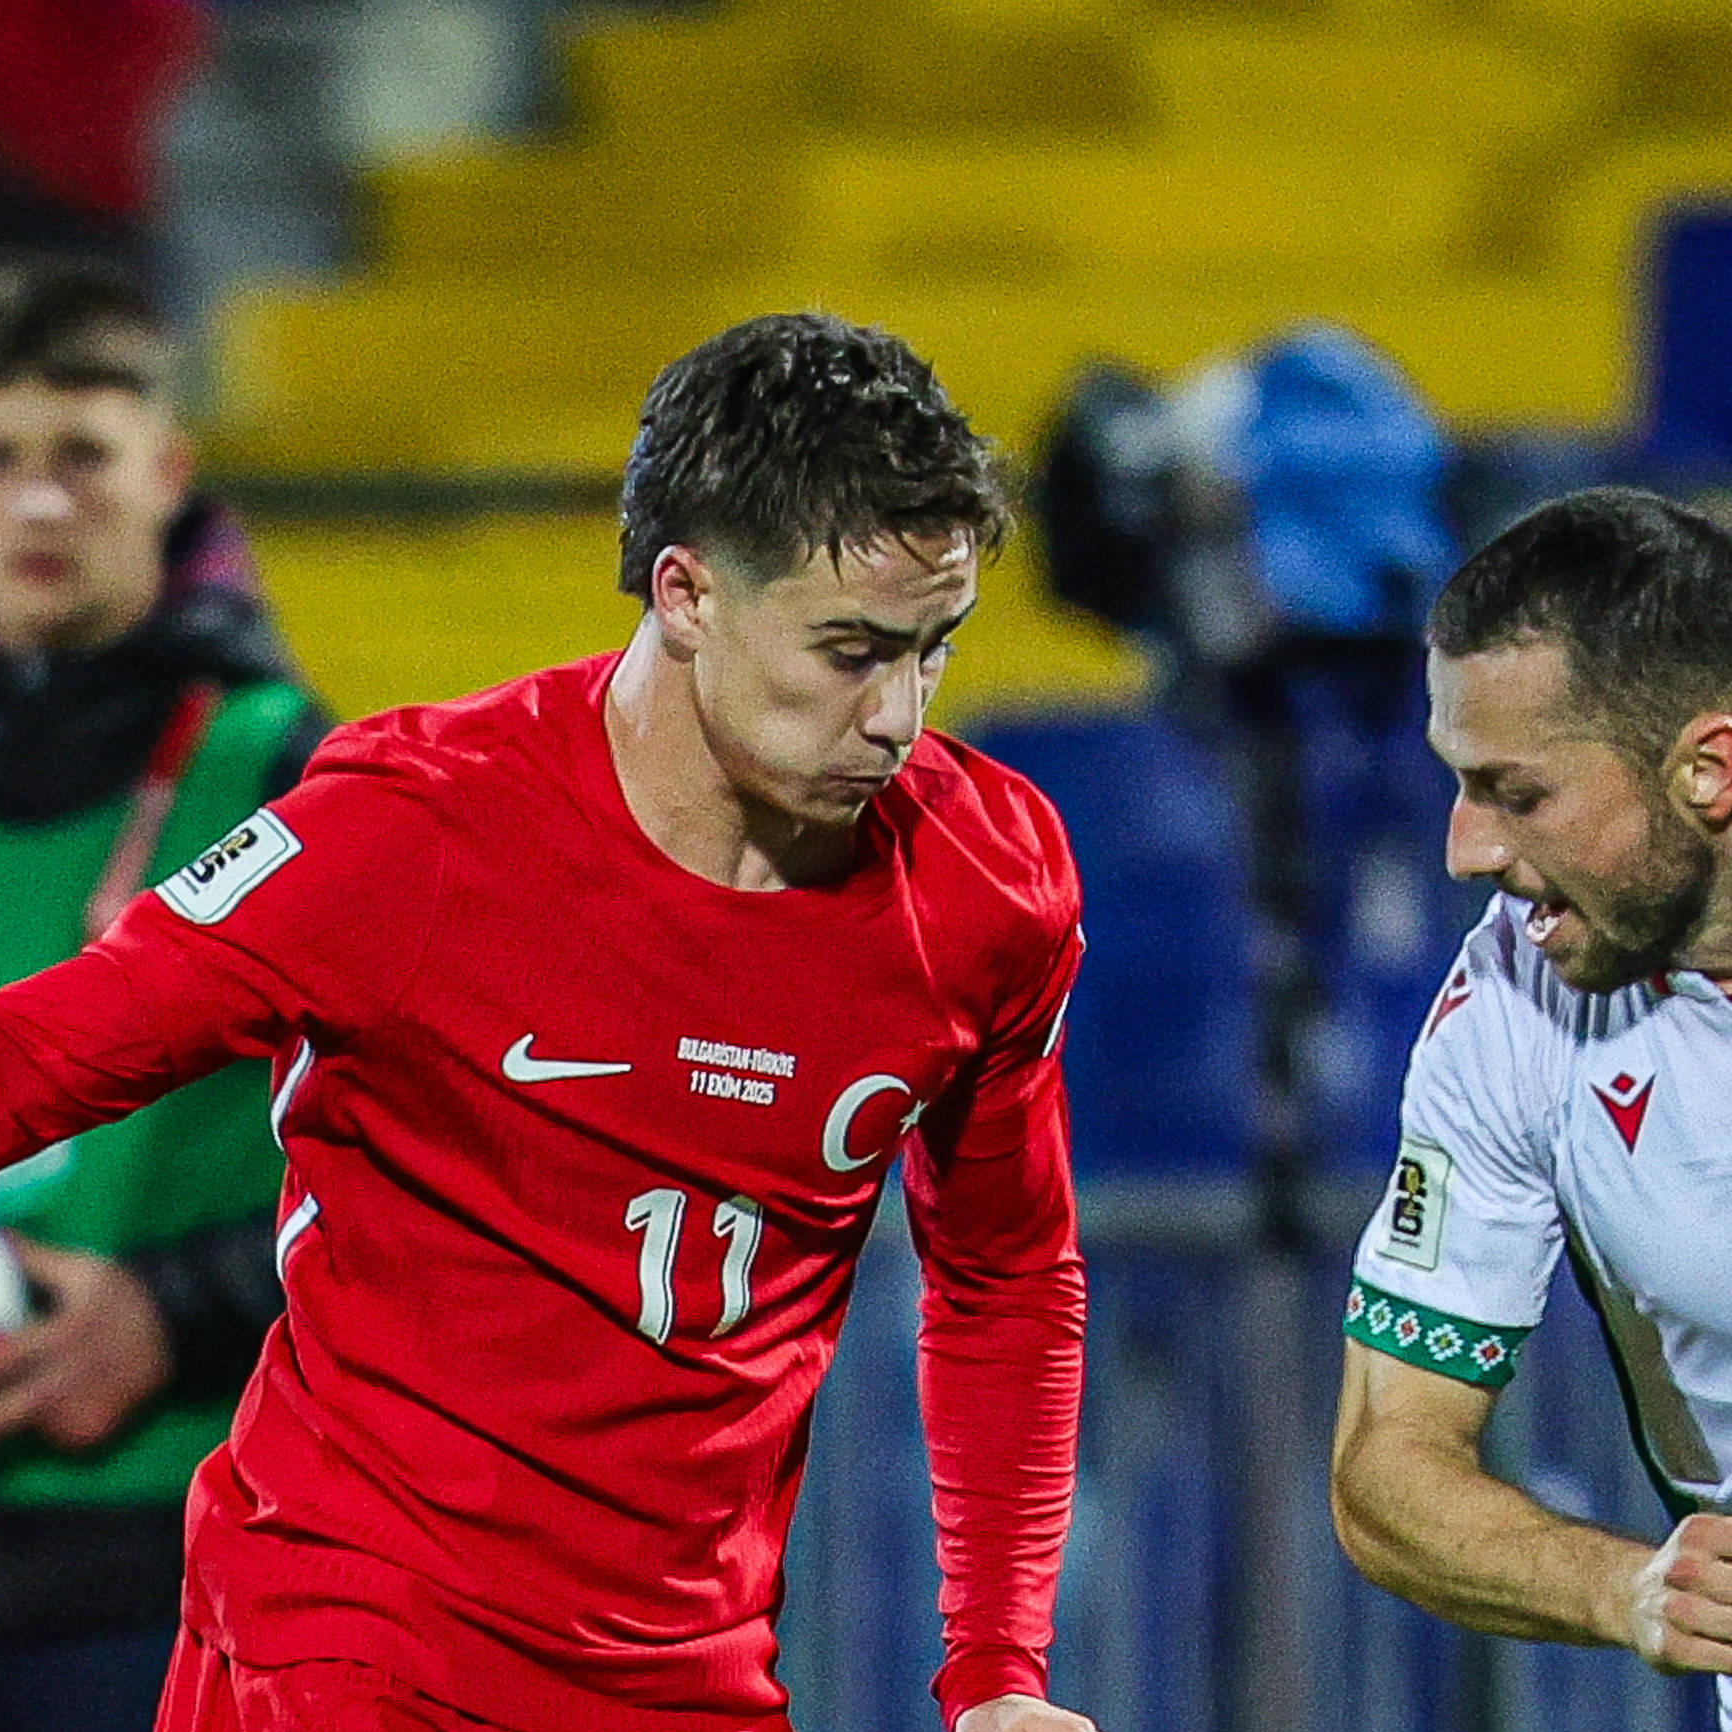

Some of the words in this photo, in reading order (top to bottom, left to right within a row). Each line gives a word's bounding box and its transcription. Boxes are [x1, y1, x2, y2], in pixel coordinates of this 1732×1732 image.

[690, 1070, 707, 1093] 11
[740, 1078, 775, 1105] 2025
[624, 1187, 763, 1344] 11
